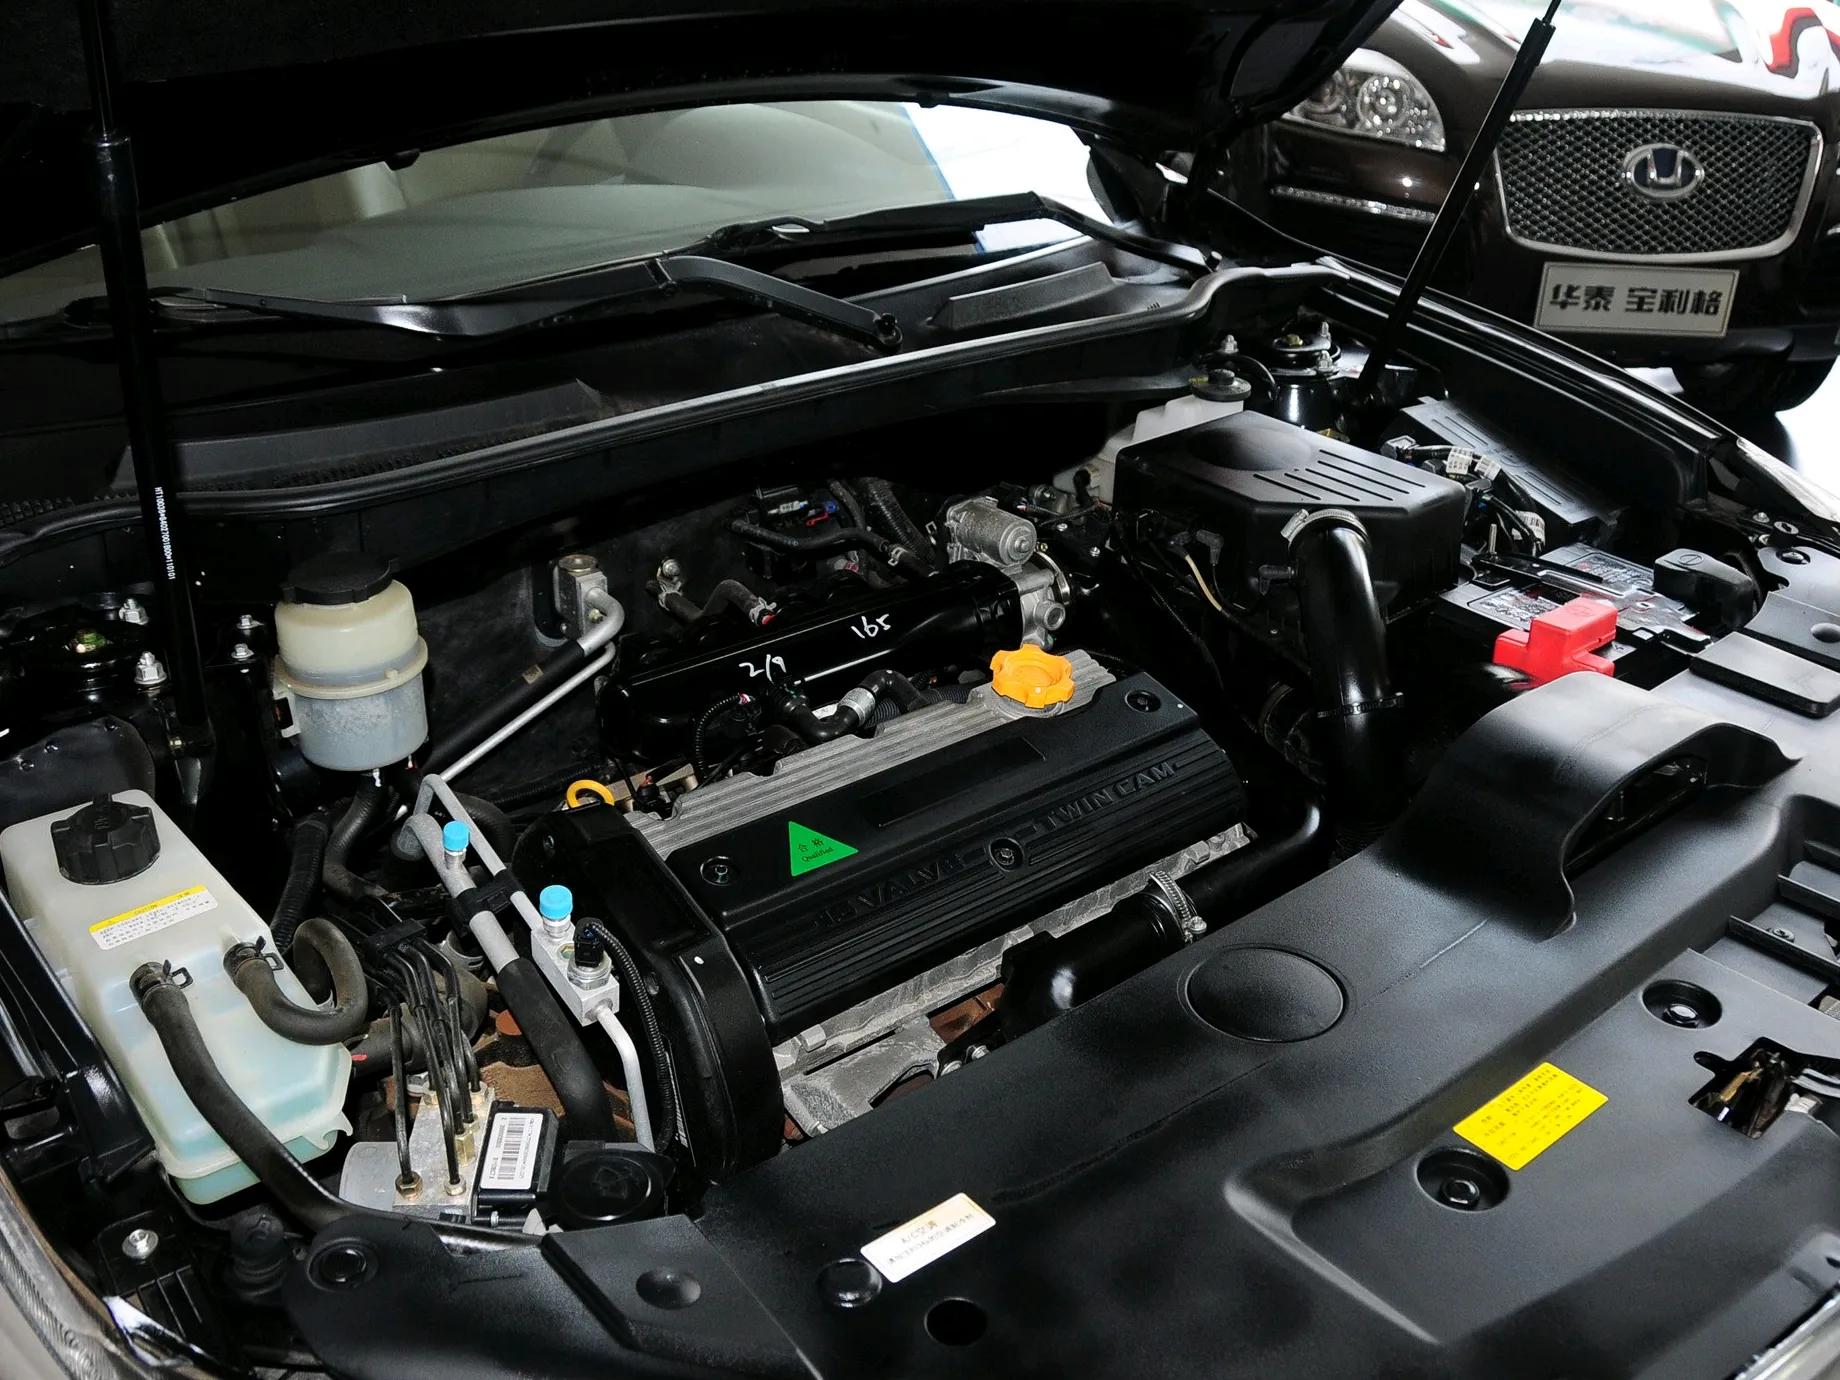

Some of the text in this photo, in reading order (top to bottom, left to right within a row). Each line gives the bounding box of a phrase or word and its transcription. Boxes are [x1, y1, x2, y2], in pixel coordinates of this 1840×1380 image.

[1549, 283, 1723, 316] 华泰 宝利格
[850, 613, 892, 640] 165
[1043, 760, 1177, 830] TWIN CAM
[801, 846, 835, 864] Qualified
